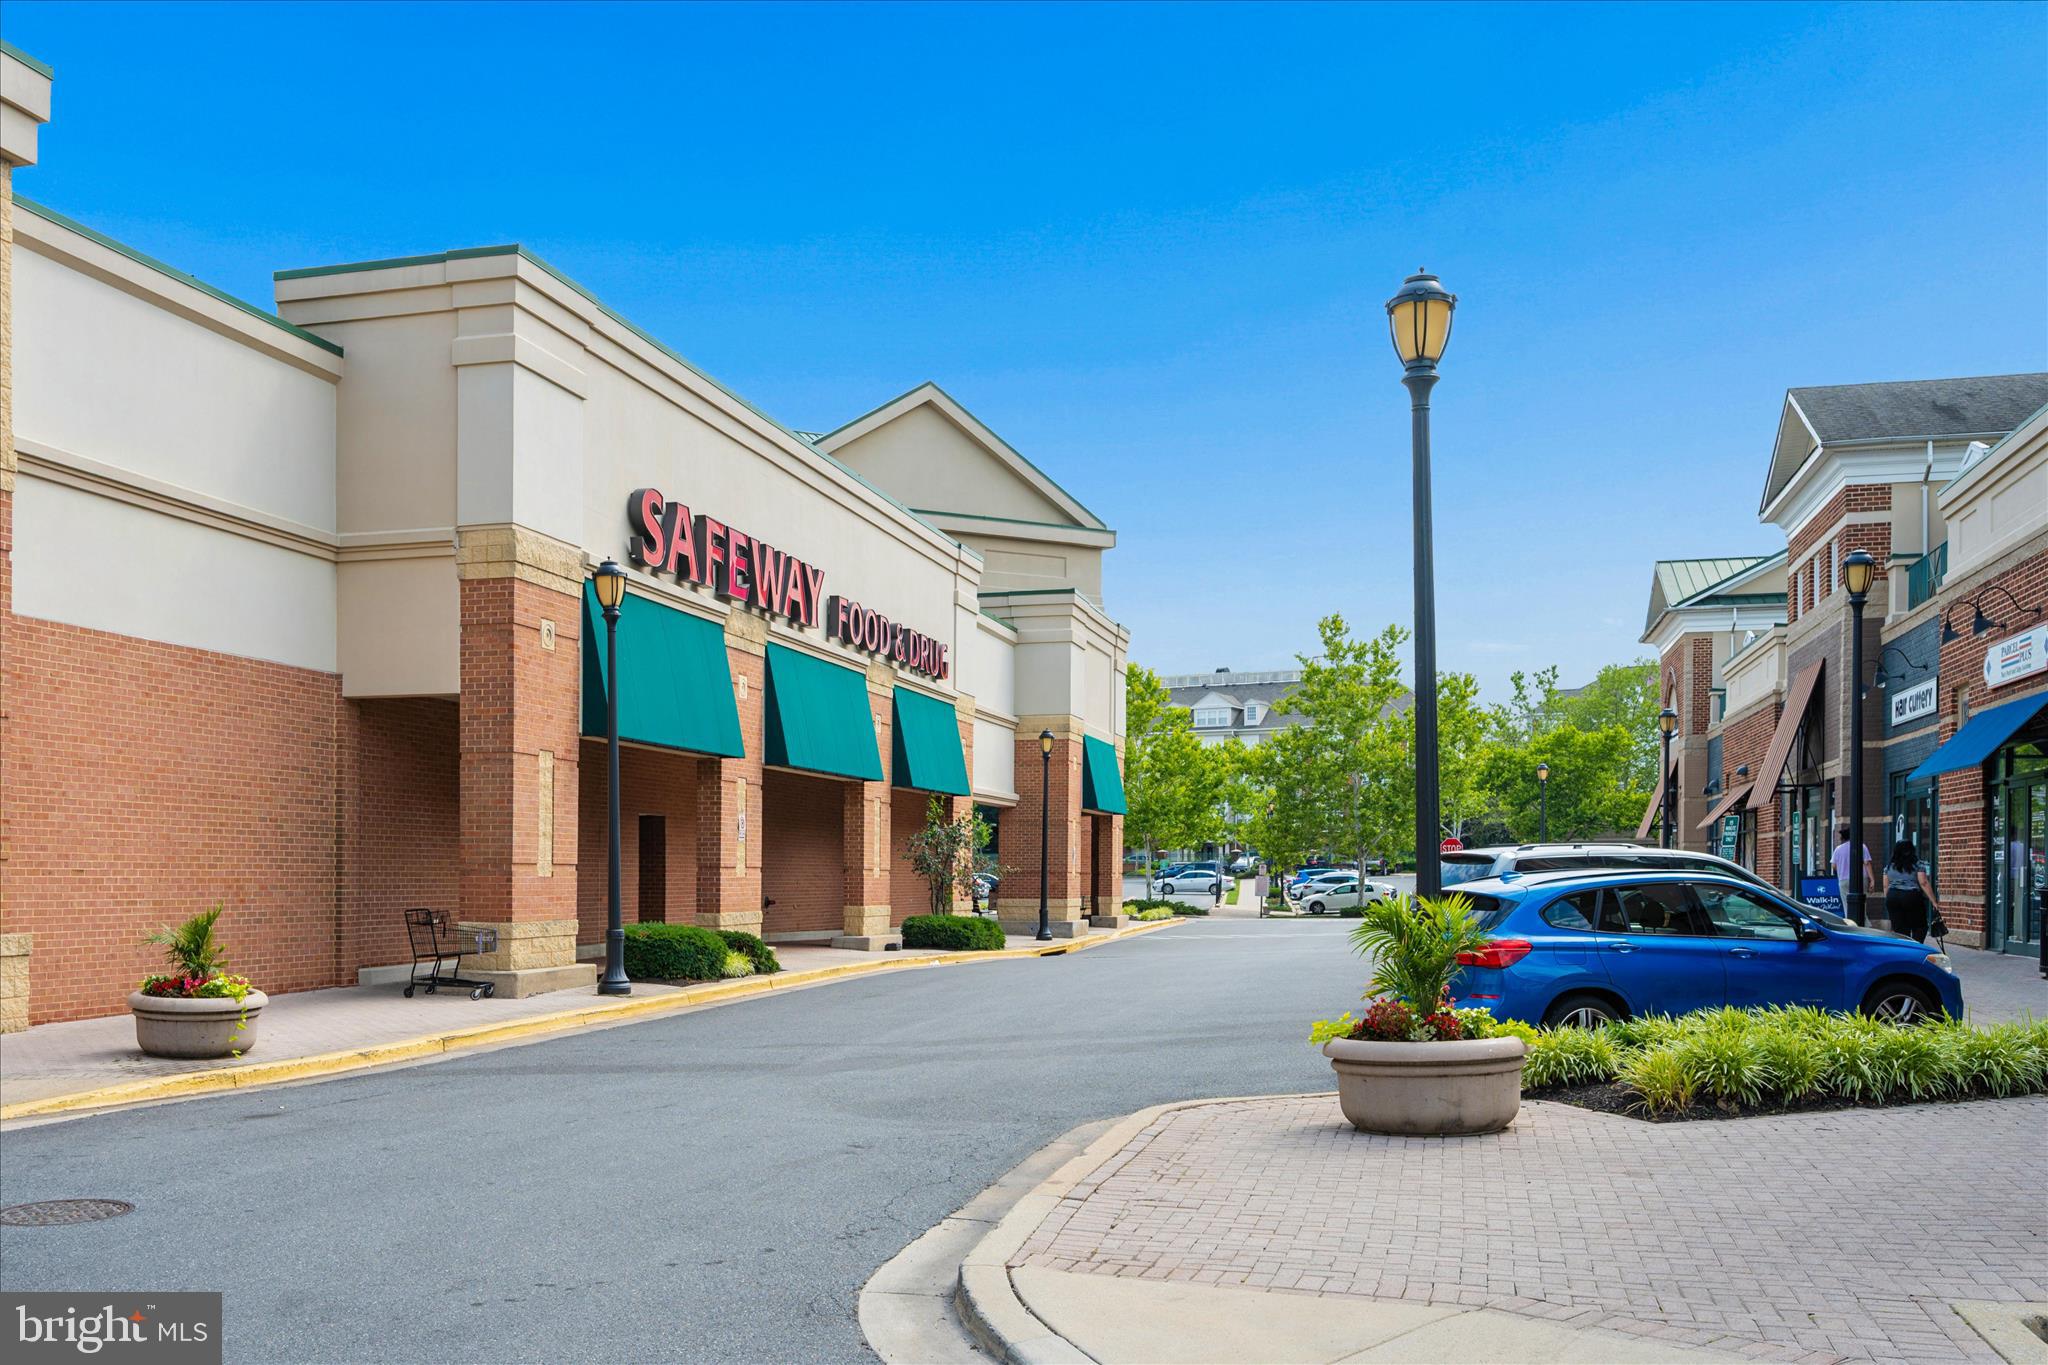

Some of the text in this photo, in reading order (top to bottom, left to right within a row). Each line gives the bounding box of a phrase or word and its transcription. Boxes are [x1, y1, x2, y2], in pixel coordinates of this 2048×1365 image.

[629, 488, 950, 681] SAFEWAY FOOD & DRUG
[2001, 641, 2018, 657] PARCEL
[2019, 649, 2032, 662] PLUS
[1442, 844, 1461, 853] STOP
[1807, 896, 1839, 904] Walk-in
